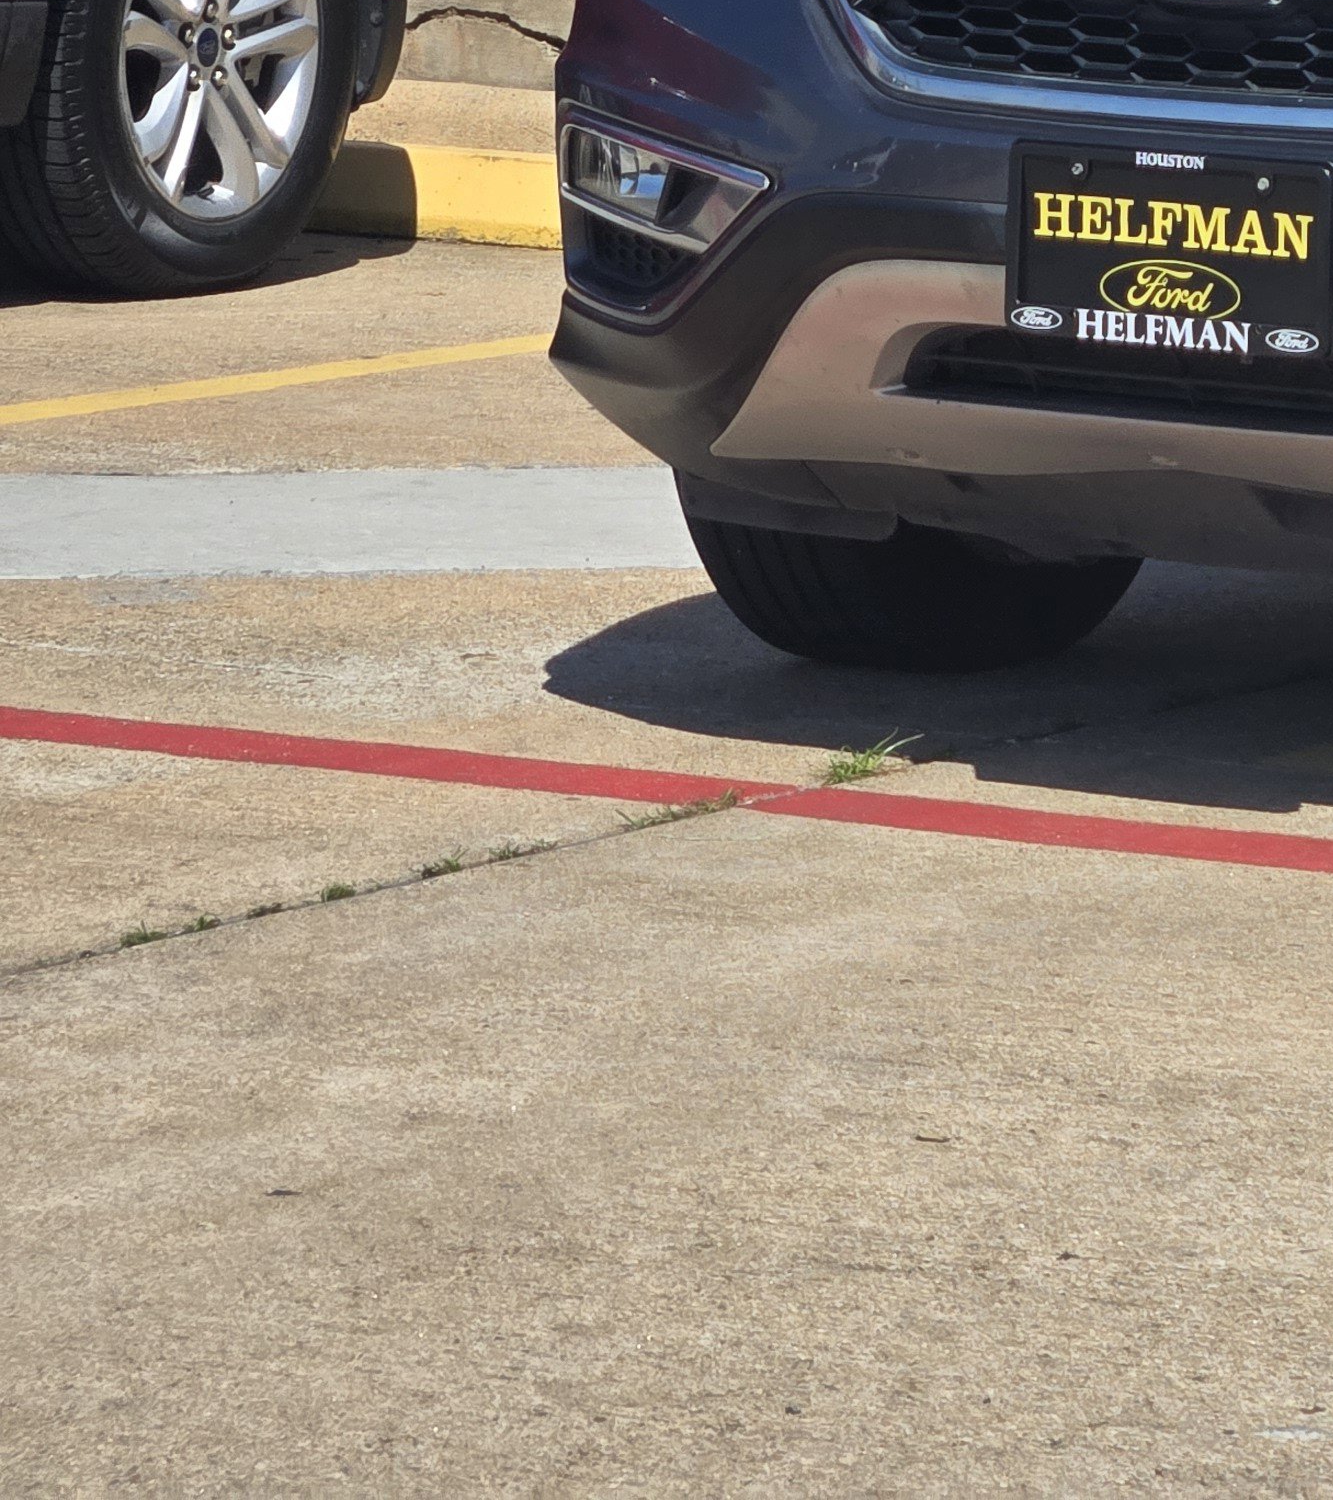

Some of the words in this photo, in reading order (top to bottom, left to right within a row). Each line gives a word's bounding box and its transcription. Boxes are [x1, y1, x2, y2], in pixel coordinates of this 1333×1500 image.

[1135, 151, 1205, 170] HOUSTON
[1032, 191, 1314, 260] HELFMAN
[1126, 265, 1215, 314] Ford
[1075, 307, 1253, 355] HELFMAN
